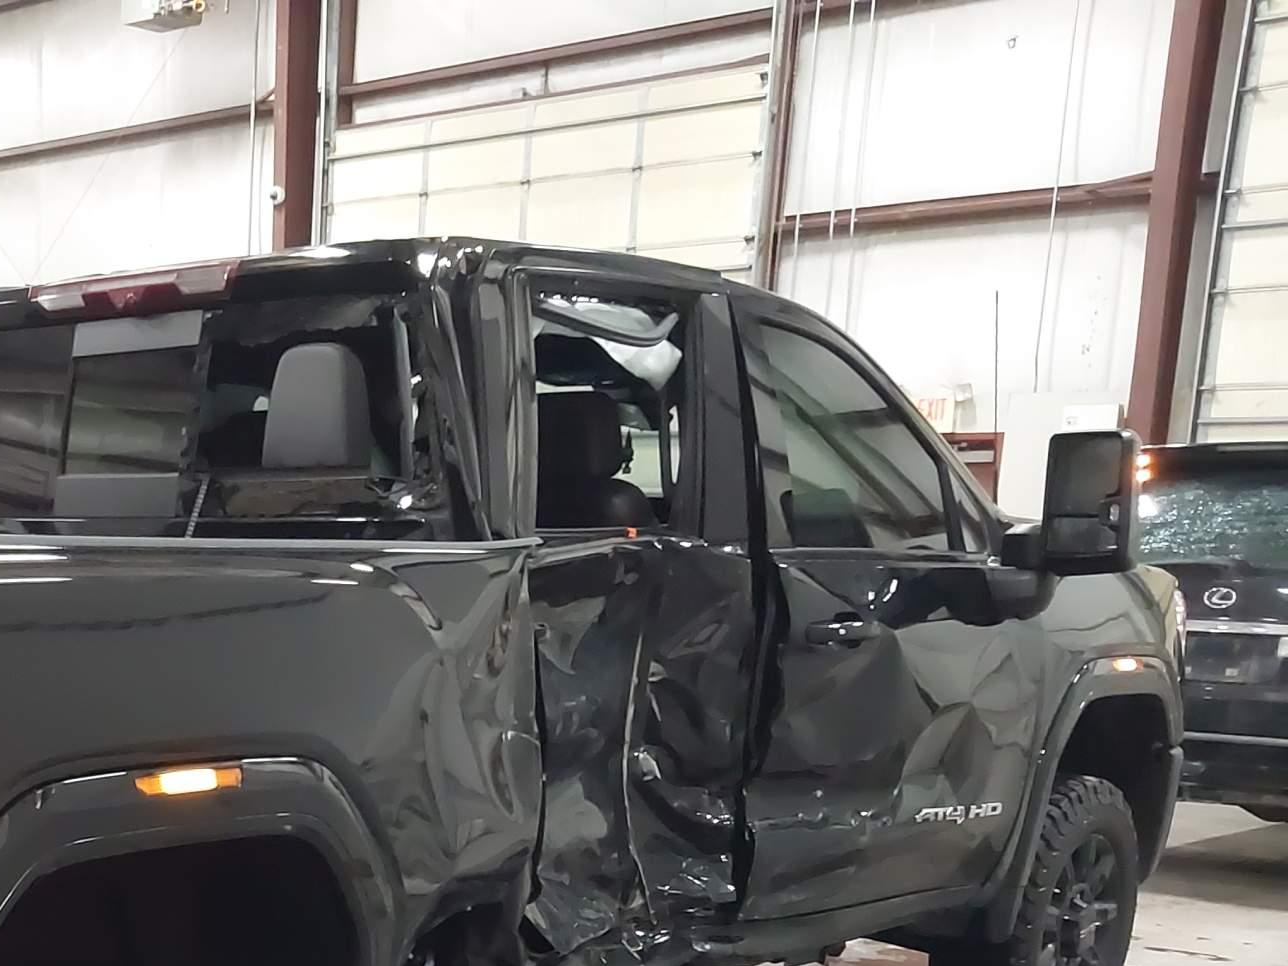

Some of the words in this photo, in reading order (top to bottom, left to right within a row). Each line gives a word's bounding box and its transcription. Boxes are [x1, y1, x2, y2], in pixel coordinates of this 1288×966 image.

[918, 397, 947, 422] EXIT
[915, 805, 965, 824] AT4
[968, 802, 1002, 818] HD
